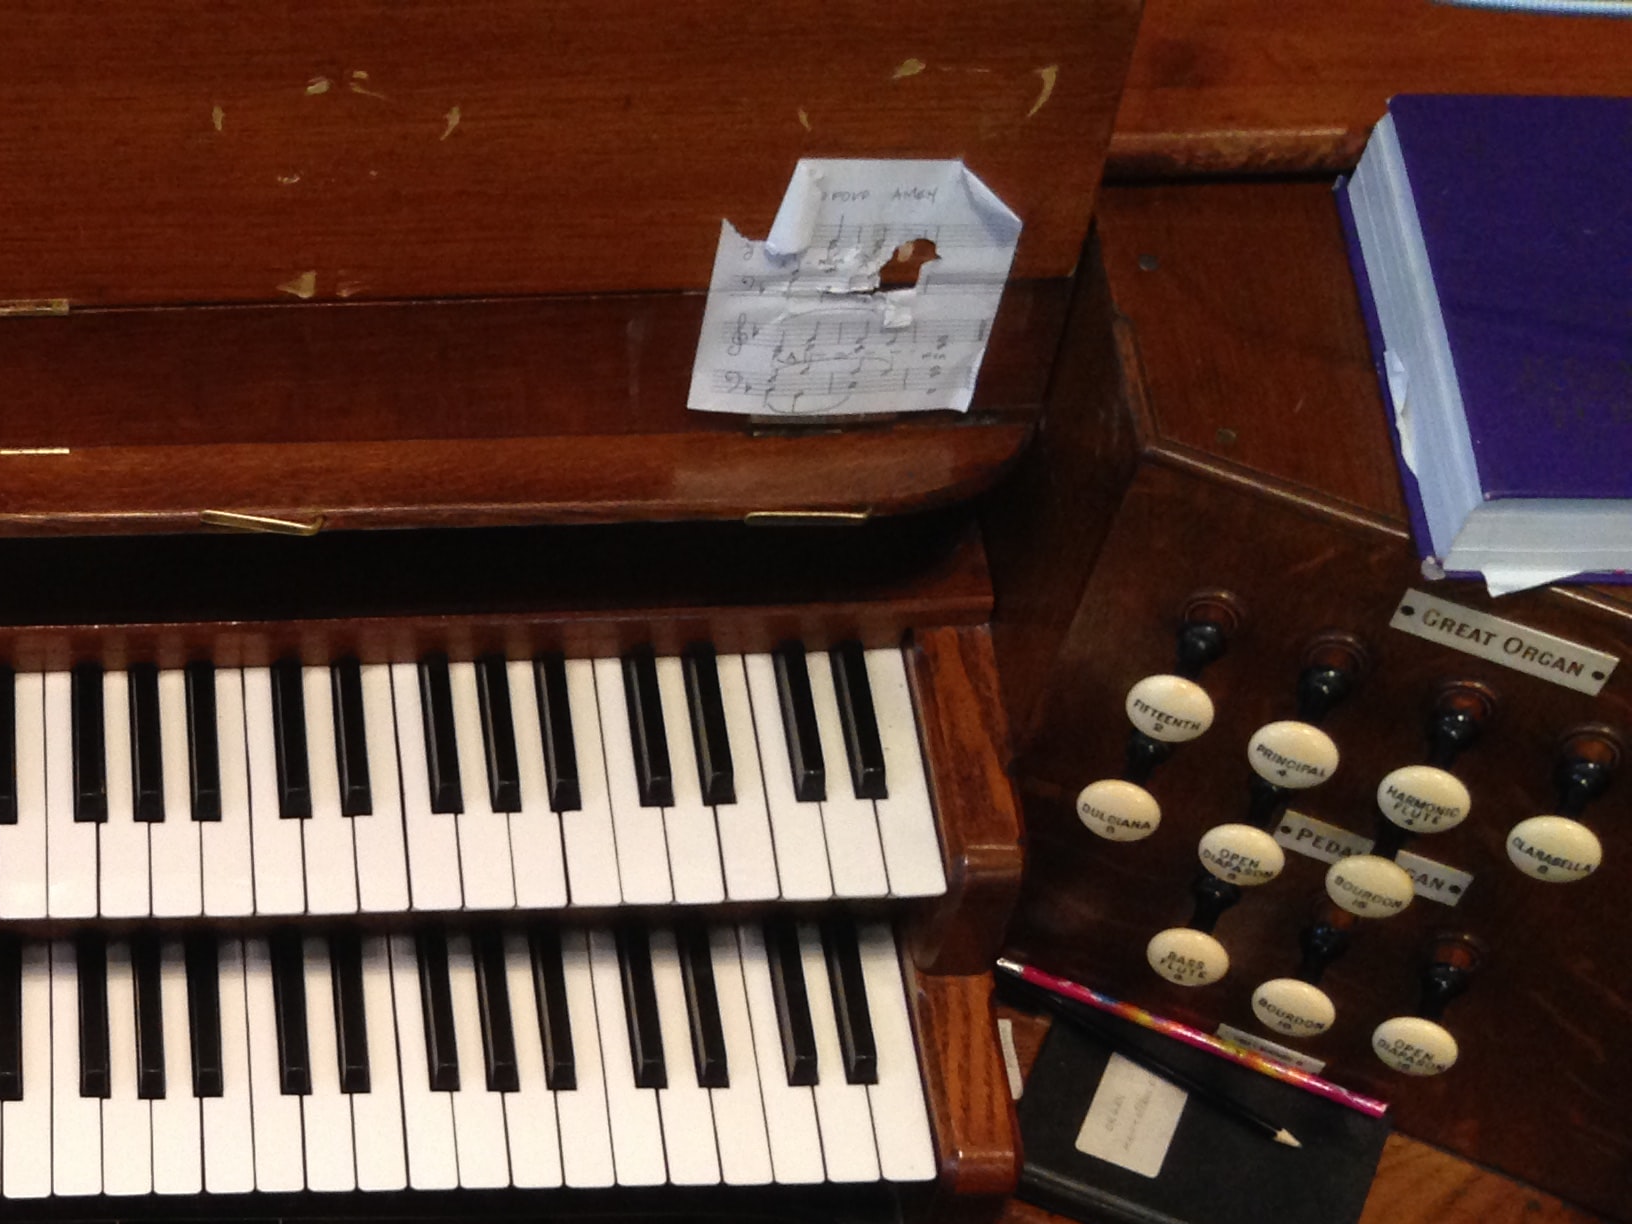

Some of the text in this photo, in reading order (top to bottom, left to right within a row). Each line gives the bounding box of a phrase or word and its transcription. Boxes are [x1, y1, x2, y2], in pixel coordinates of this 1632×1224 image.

[1422, 608, 1585, 677] GREAT ORGAN
[1133, 699, 1202, 731] FIFTEENTH
[1256, 743, 1326, 777] PRINCIPAL
[1082, 803, 1151, 831] DULCIANA
[1386, 785, 1460, 818] HARMONIC
[1393, 803, 1441, 825] FLUTE
[1295, 827, 1362, 857] PEDA
[1220, 848, 1261, 869] OPEN
[1334, 875, 1403, 909] BOURDON
[1167, 951, 1206, 970] BASS
[1258, 997, 1326, 1030] BOURDON
[1394, 1038, 1434, 1061] OPEN
